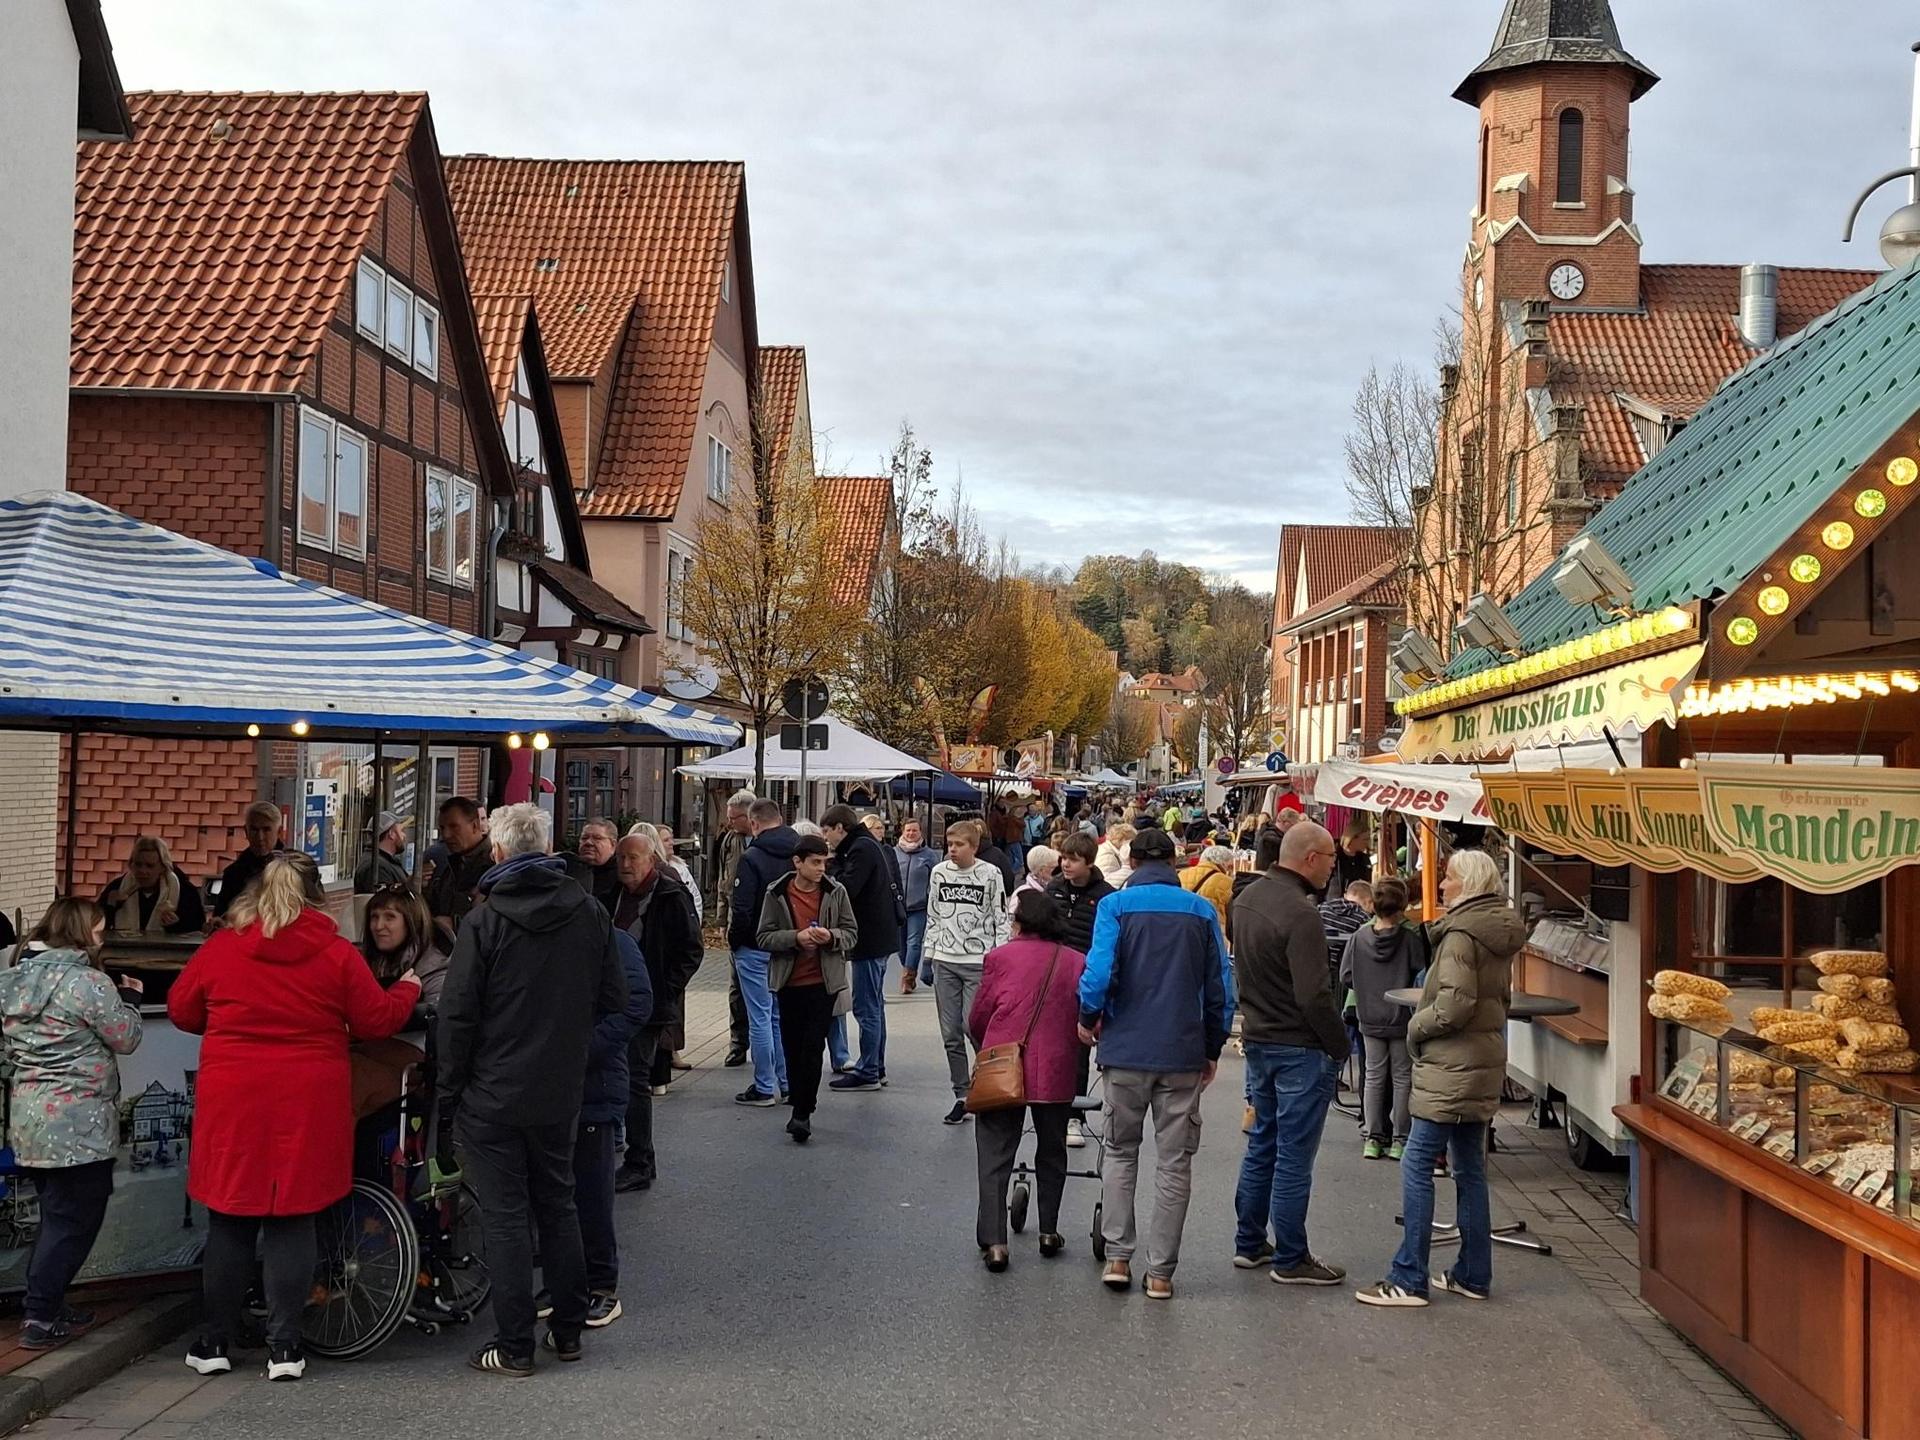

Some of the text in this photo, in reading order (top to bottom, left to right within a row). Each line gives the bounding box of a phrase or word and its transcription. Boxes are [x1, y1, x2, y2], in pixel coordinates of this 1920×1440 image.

[1487, 680, 1608, 736] Nusshaus
[1543, 804, 1581, 839] W
[1590, 803, 1647, 847] Kür
[1642, 806, 1726, 853] Sonnen
[1731, 803, 1920, 866] Mandeln
